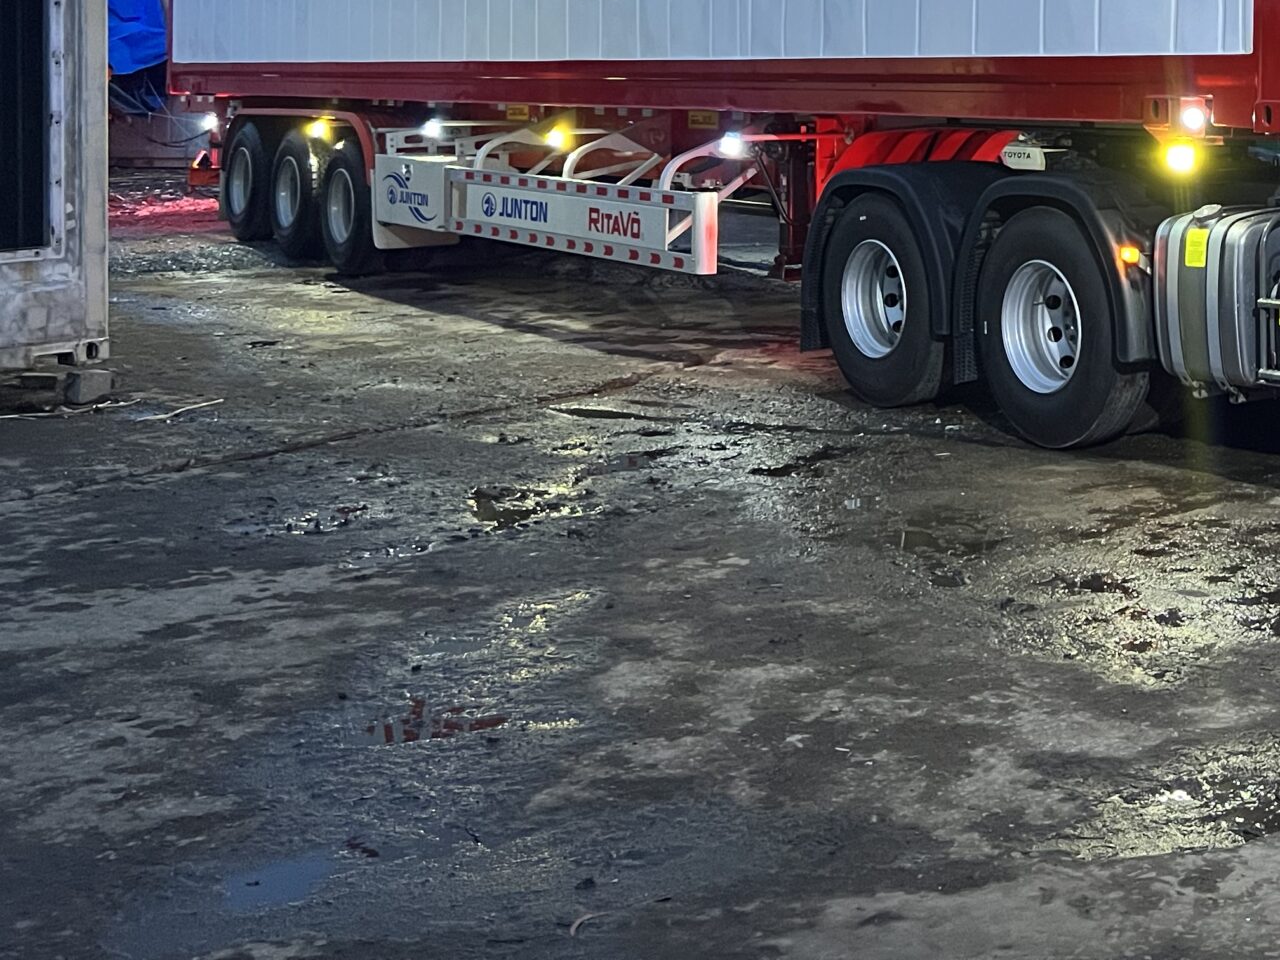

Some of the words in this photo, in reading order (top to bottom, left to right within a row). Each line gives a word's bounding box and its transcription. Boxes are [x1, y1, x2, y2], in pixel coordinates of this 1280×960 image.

[1003, 151, 1031, 159] TOYOTA
[399, 190, 429, 207] JUNTON
[499, 197, 548, 223] JUNTON
